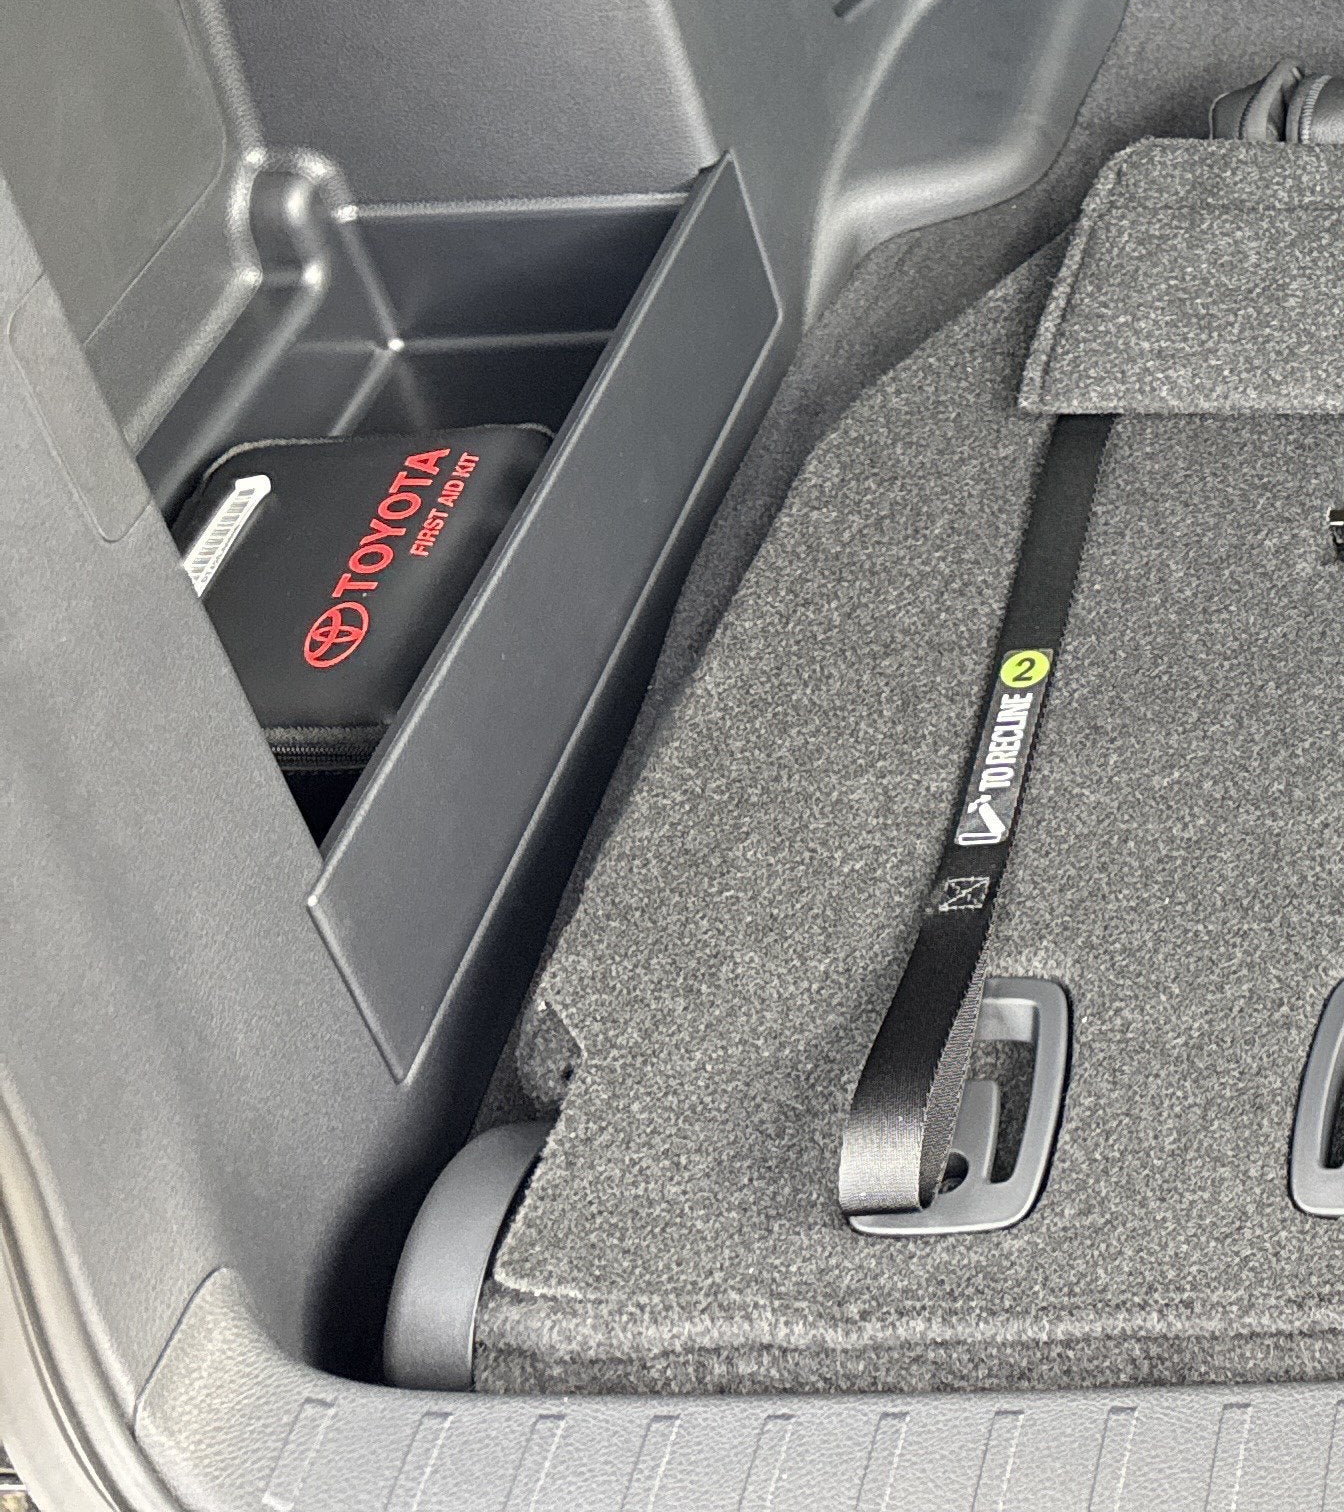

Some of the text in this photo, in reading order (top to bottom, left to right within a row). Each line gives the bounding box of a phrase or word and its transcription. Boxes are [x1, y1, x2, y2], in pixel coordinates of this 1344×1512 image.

[331, 447, 451, 598] TOYOTA
[409, 451, 480, 558] FIRST AID KIT
[1012, 657, 1037, 683] 2
[979, 692, 1034, 792] TO RECLINE
